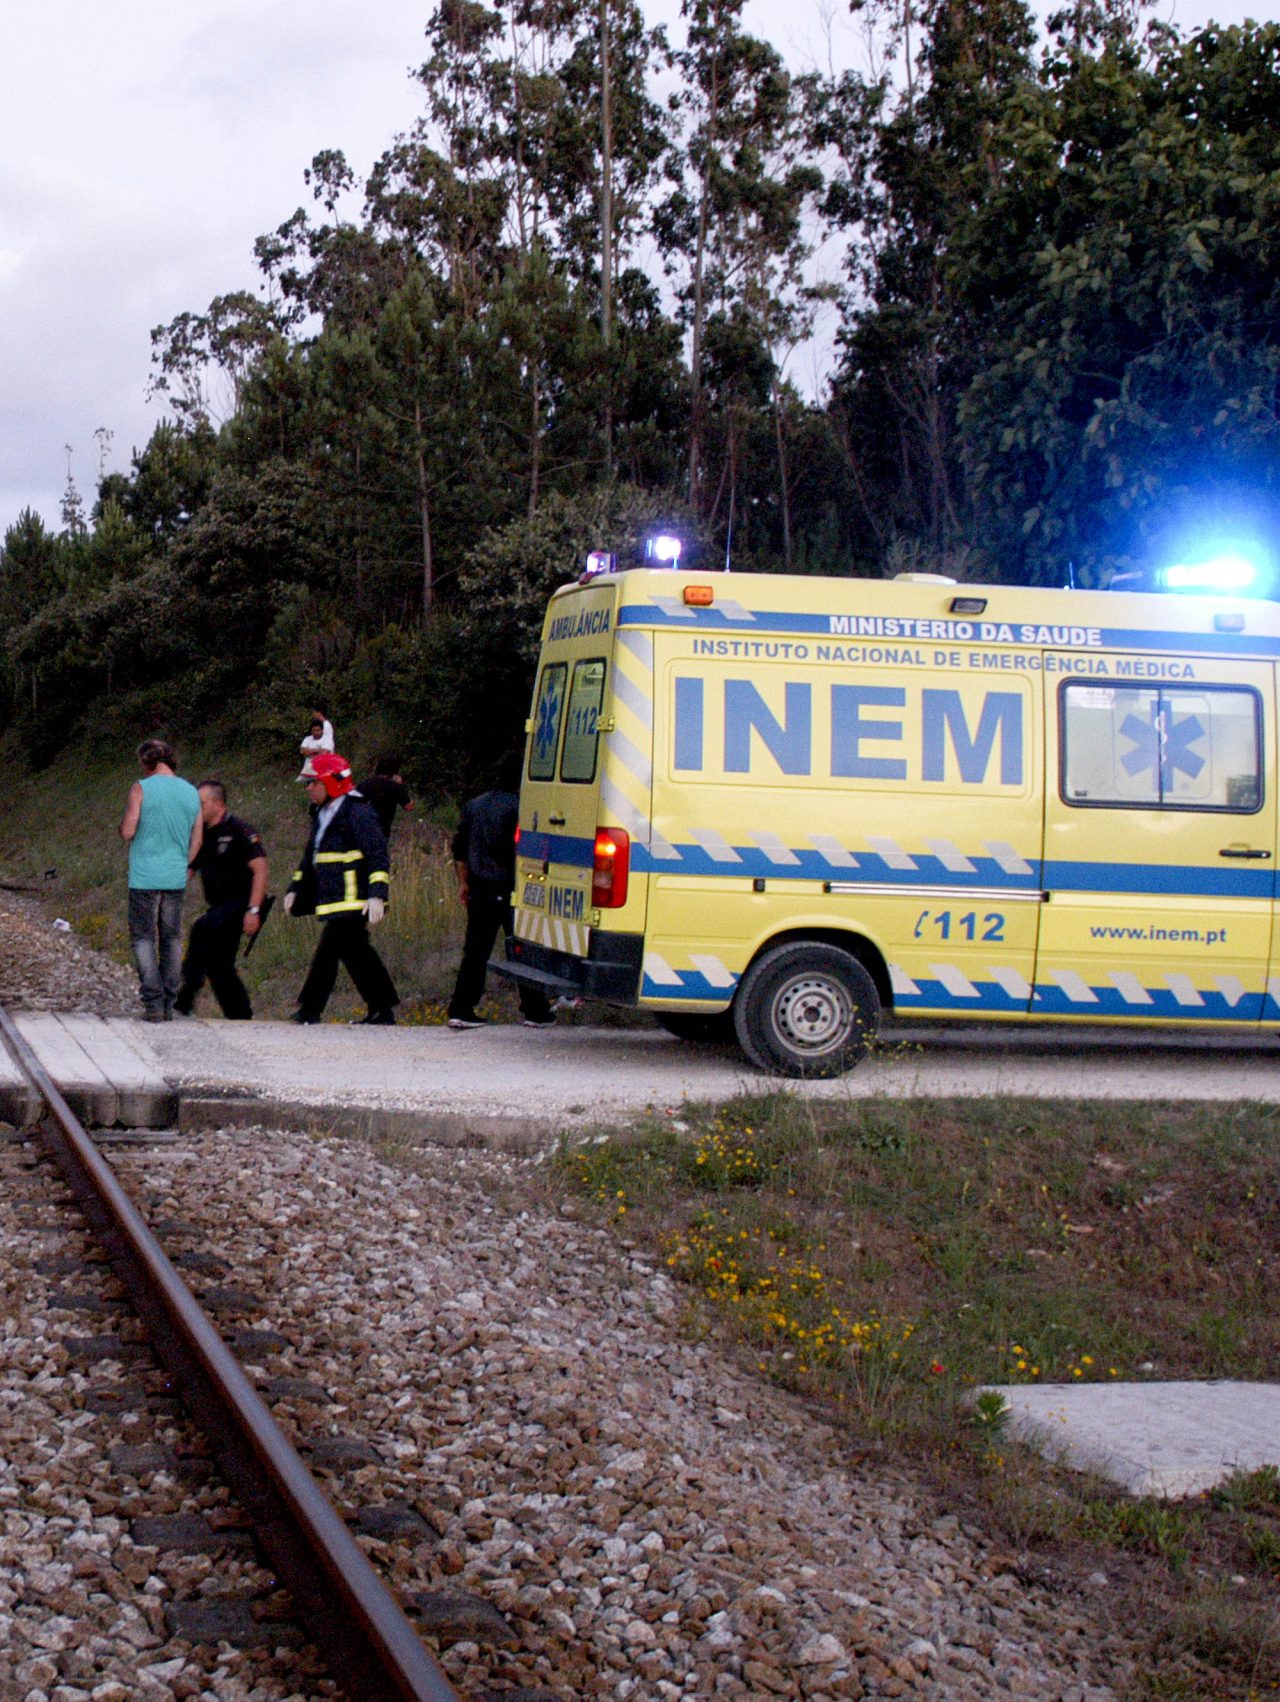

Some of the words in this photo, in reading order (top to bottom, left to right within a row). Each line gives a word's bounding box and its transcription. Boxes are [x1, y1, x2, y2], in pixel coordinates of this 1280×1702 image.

[829, 616, 974, 640] MINISTERIO
[980, 623, 1014, 642] DA
[1020, 626, 1103, 646] SAUDE
[693, 639, 809, 660] INSTITUTO
[816, 646, 926, 665] NACIONAL
[934, 651, 961, 667] DE
[969, 653, 1109, 675] EMERGÊNCIA
[1116, 658, 1196, 679] MÉDICA
[575, 707, 598, 735] 112
[674, 677, 1023, 786] INEM
[549, 885, 584, 920] INEM
[934, 911, 1006, 942] 112
[1090, 925, 1227, 946] www.inem.pt
